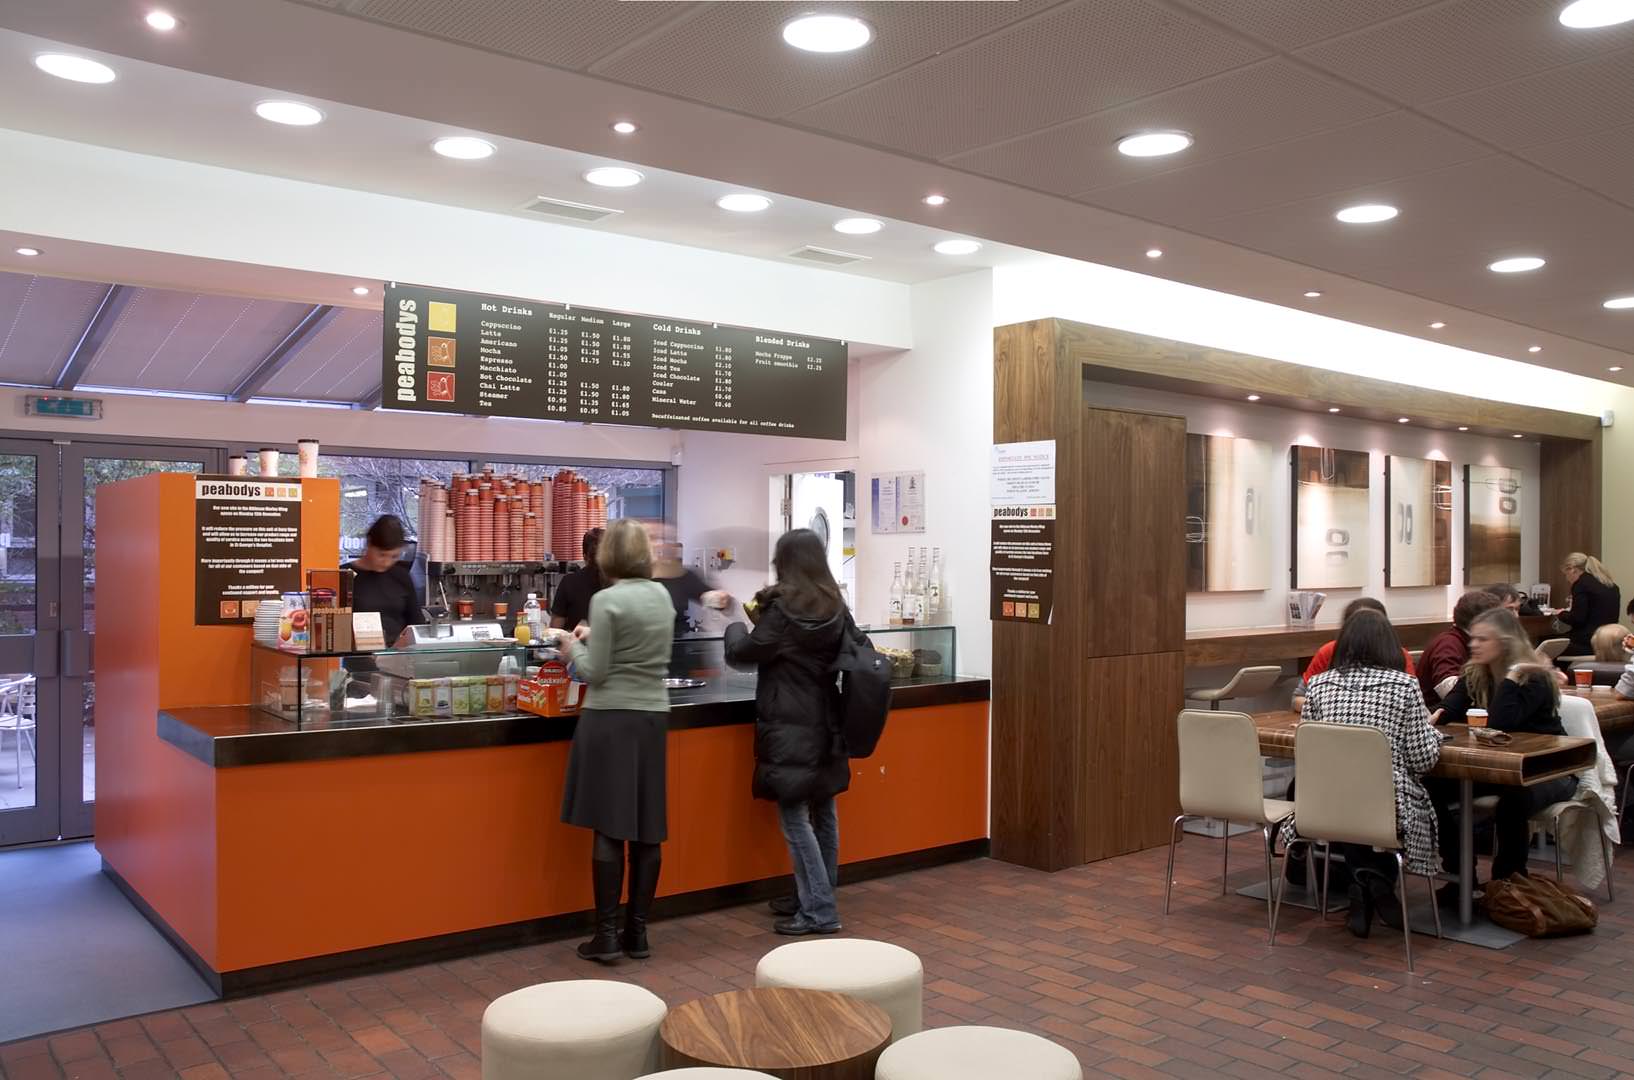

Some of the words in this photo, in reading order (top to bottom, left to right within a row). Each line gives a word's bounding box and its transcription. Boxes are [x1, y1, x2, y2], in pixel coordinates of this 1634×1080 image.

[481, 303, 497, 312] Hot
[502, 305, 532, 316] Drinks
[548, 312, 576, 322] Regular
[580, 316, 604, 324] Medium
[612, 319, 631, 328] Large
[480, 320, 521, 331] Cappuccino
[652, 323, 671, 332] Cold
[675, 326, 701, 336] Drinks
[480, 329, 501, 337] Latte
[480, 338, 517, 347] Americano
[670, 341, 704, 351] Cappuccino
[755, 335, 783, 345] Blended
[786, 339, 809, 348] Drinks
[395, 299, 418, 402] peabodys
[480, 346, 500, 354] Mocha
[480, 355, 512, 365] Espresso
[479, 364, 516, 373] Macchiato
[495, 375, 532, 384] Chocolate
[669, 373, 700, 381] Chocolate
[479, 391, 508, 399] Steamer
[202, 484, 260, 497] peabodys
[994, 506, 1028, 518] peabodys
